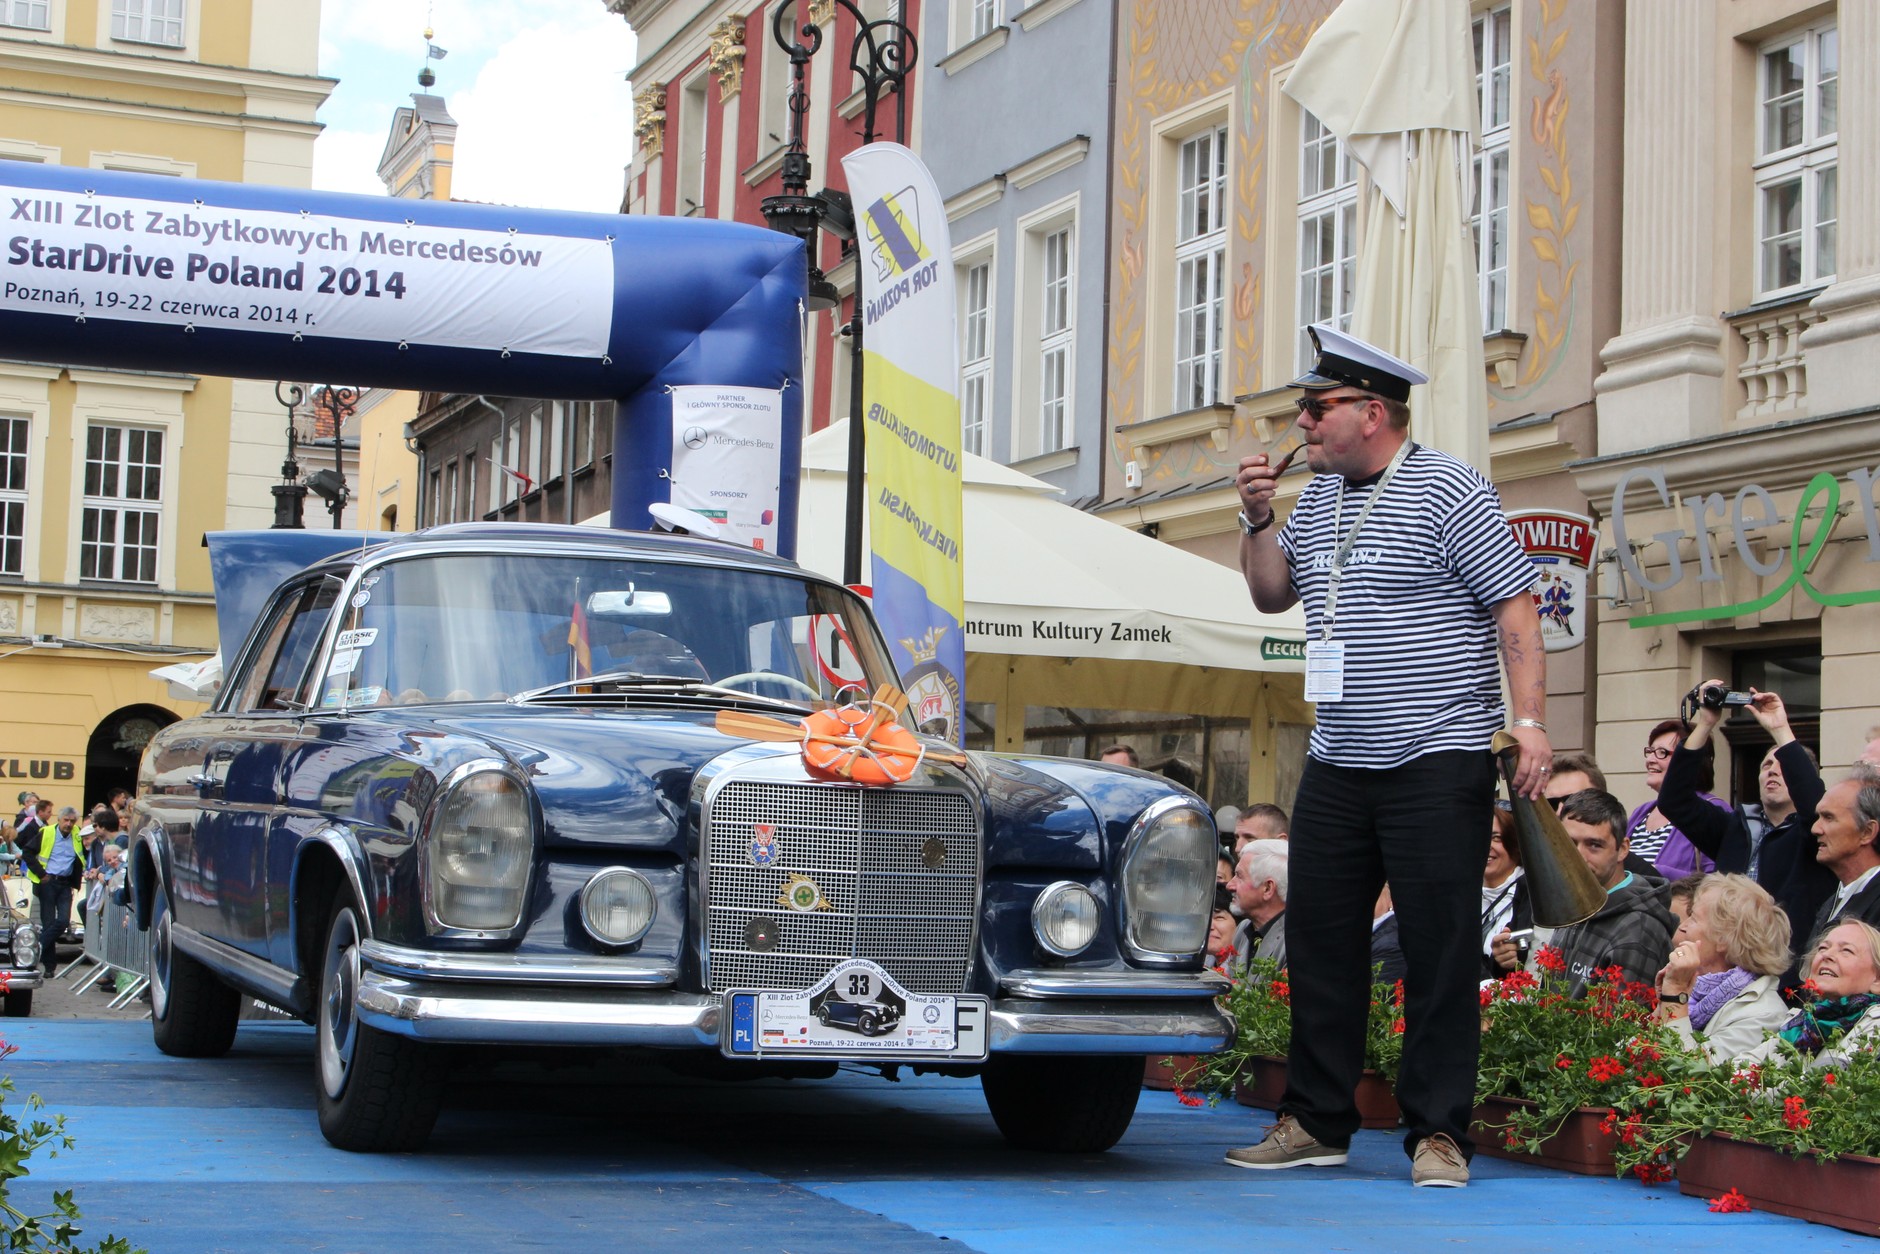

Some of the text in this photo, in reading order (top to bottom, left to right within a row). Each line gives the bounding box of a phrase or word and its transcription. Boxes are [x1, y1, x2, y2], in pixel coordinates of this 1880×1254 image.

[10, 197, 542, 267] XIII Zlot Zabytkowych Mercedesów
[8, 236, 406, 299] StarDrive Poland 2014
[4, 282, 317, 326] Poznań, 19-22 czerwca 2014 r.
[691, 400, 720, 409] GŁÓWNY
[722, 402, 752, 410] SPONSOR
[753, 404, 771, 412] ZLOTU
[713, 436, 774, 450] Mercedes-Benz
[710, 490, 748, 499] SPONSORZY
[1032, 620, 1103, 644] Kultury
[1110, 623, 1172, 644] Zamek
[1265, 642, 1300, 657] LECH
[796, 973, 835, 1000] Zabytkowych
[835, 960, 876, 973] Mercedesów
[905, 993, 927, 1003] Poland
[849, 974, 869, 995] 33
[736, 1030, 751, 1042] PL
[809, 1039, 835, 1047] Poznań,
[837, 1039, 854, 1047] 19-22
[883, 1039, 898, 1047] 2014
